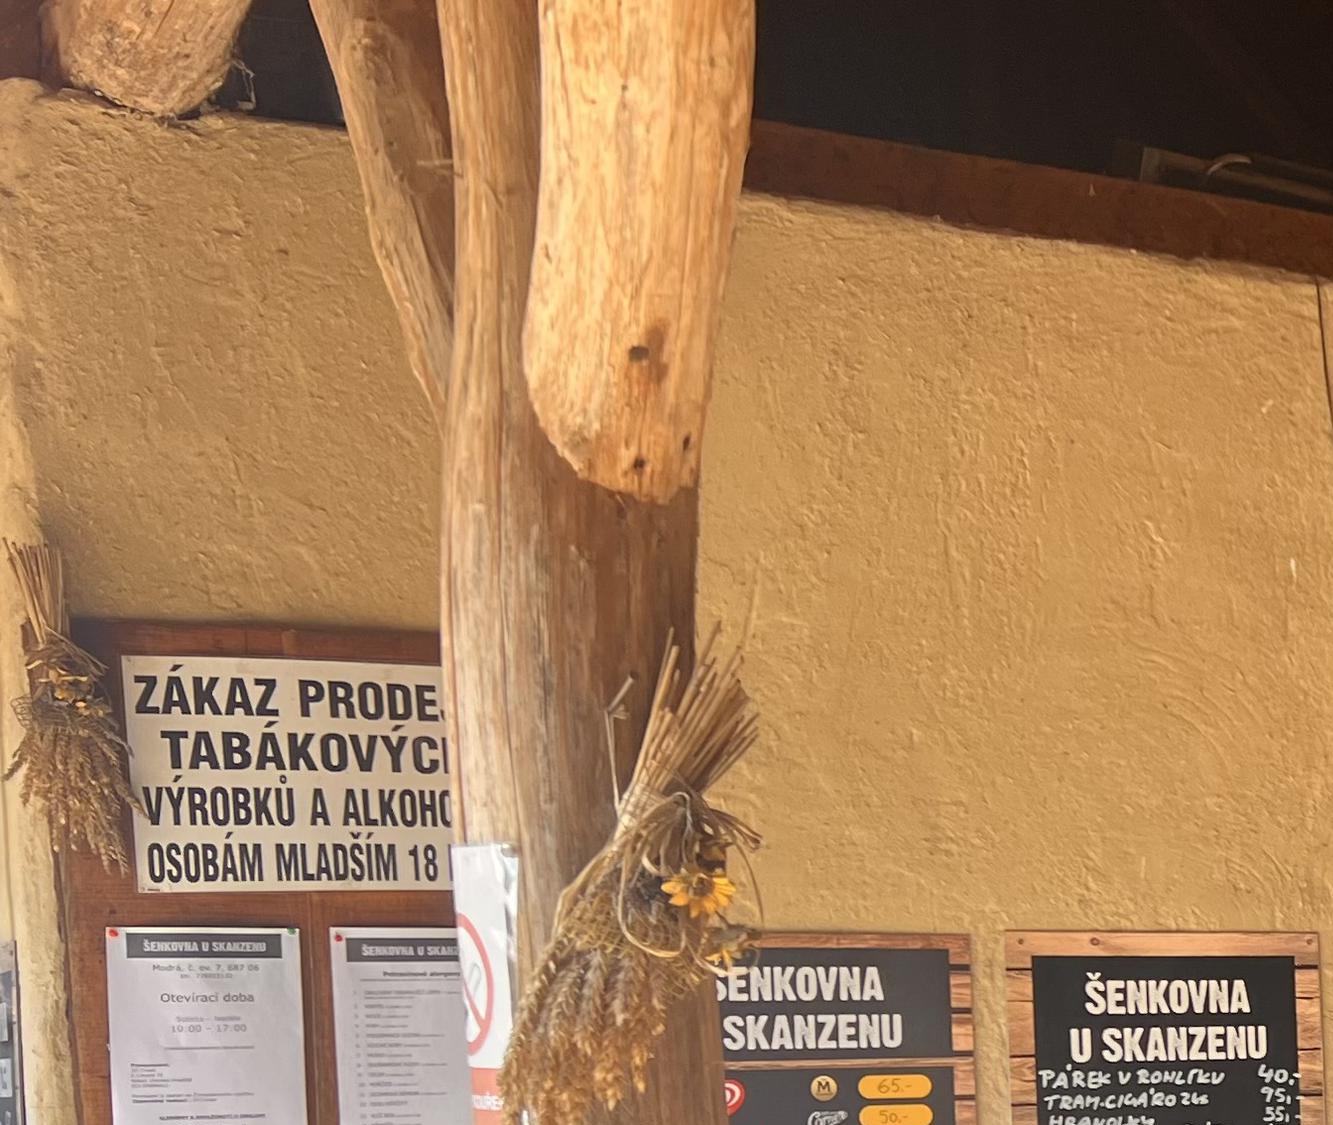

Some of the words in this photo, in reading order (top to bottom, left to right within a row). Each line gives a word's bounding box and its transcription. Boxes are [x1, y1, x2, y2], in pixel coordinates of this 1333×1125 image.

[134, 664, 279, 716] ZÁKAZ
[143, 775, 295, 827] VÝROBKŮ
[310, 788, 330, 827] A
[148, 832, 264, 883] OSOBÁM
[276, 832, 398, 882] MLADŠÍM
[408, 844, 439, 882] 18
[143, 939, 199, 952] ŠENKOVNA
[202, 941, 209, 952] U
[212, 941, 267, 952] SKANZENU
[417, 945, 425, 956] U
[222, 992, 255, 1003] doba
[1084, 972, 1251, 1016] ŠENKOVNA
[722, 1014, 902, 1050] SKANZENU
[1070, 1028, 1091, 1063] U
[1103, 1025, 1268, 1061] SKANZENU
[1039, 1065, 1111, 1089] PÁREK
[1118, 1071, 1131, 1085] V
[1136, 1069, 1225, 1085] ROHLÍKU
